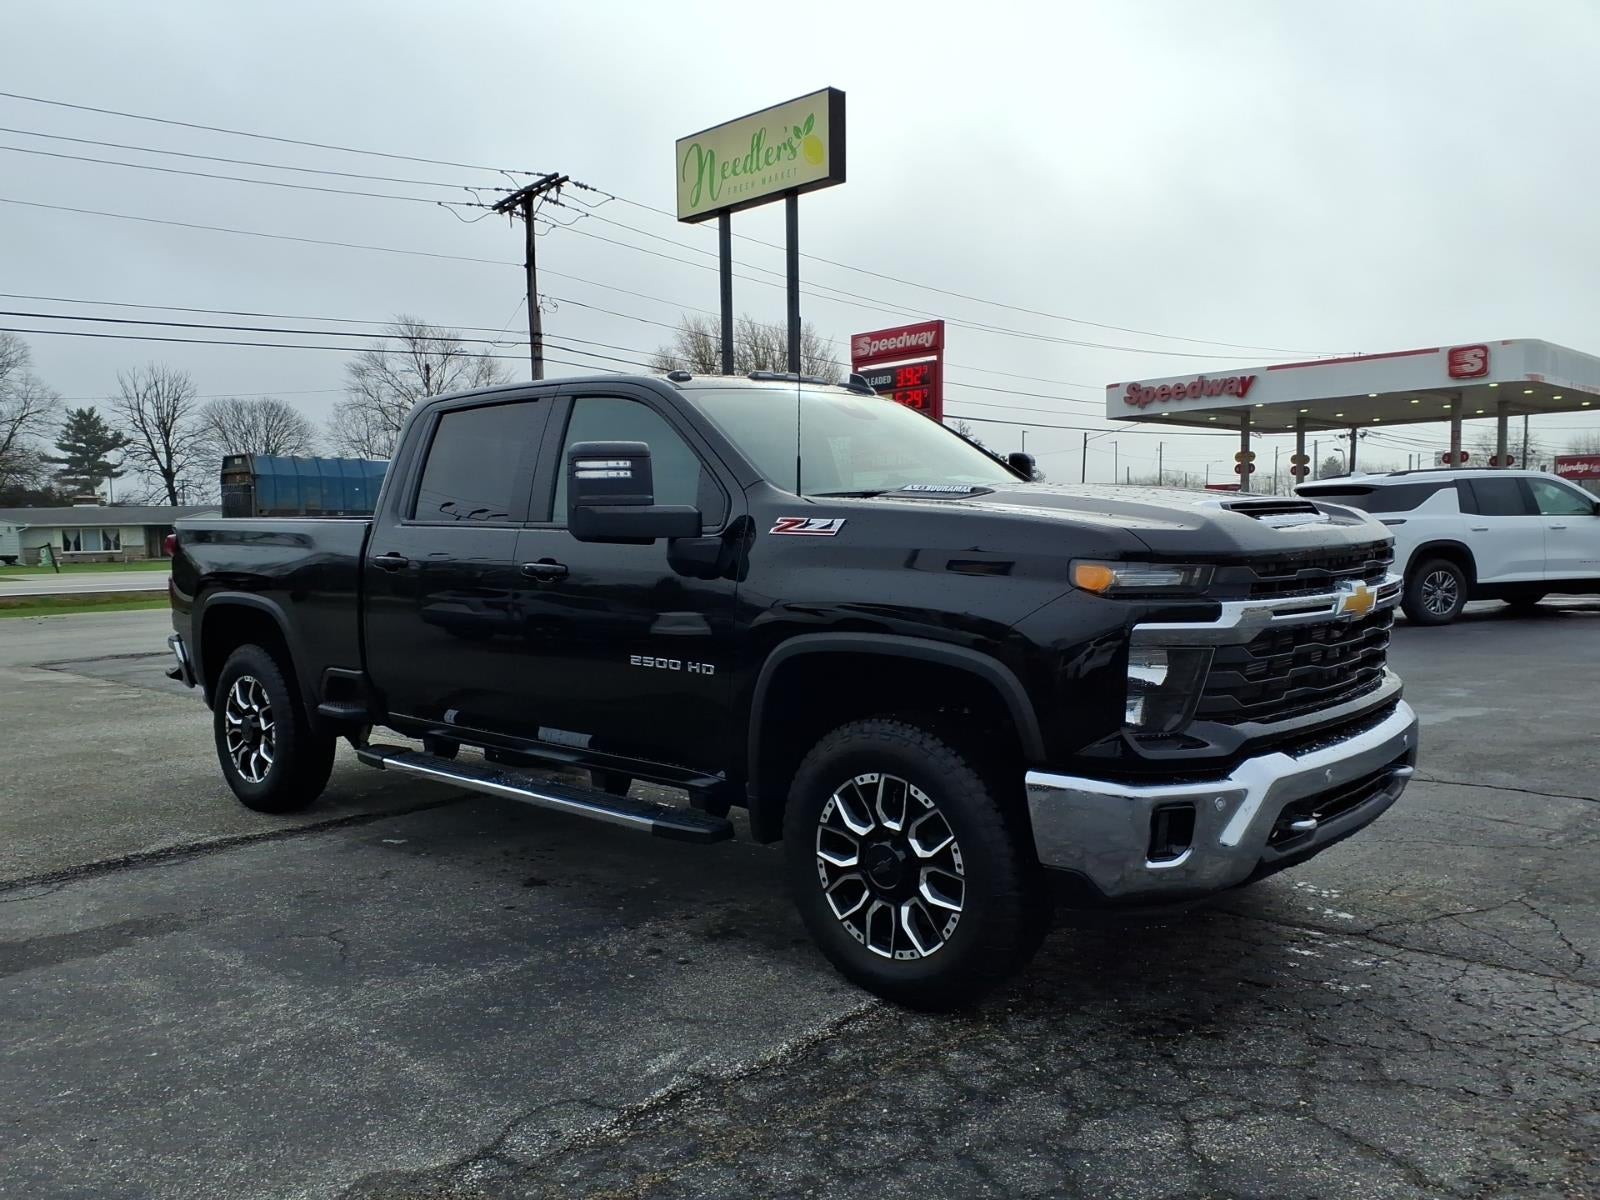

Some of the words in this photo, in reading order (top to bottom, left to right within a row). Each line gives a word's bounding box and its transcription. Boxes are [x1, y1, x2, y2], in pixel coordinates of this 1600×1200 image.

[682, 126, 801, 208] Needler's
[855, 330, 936, 356] Speedway
[865, 375, 892, 386] LEADED
[1123, 375, 1257, 410] Speedway
[768, 516, 847, 537] Z71
[630, 654, 681, 671] 2500
[687, 661, 715, 675] HD
